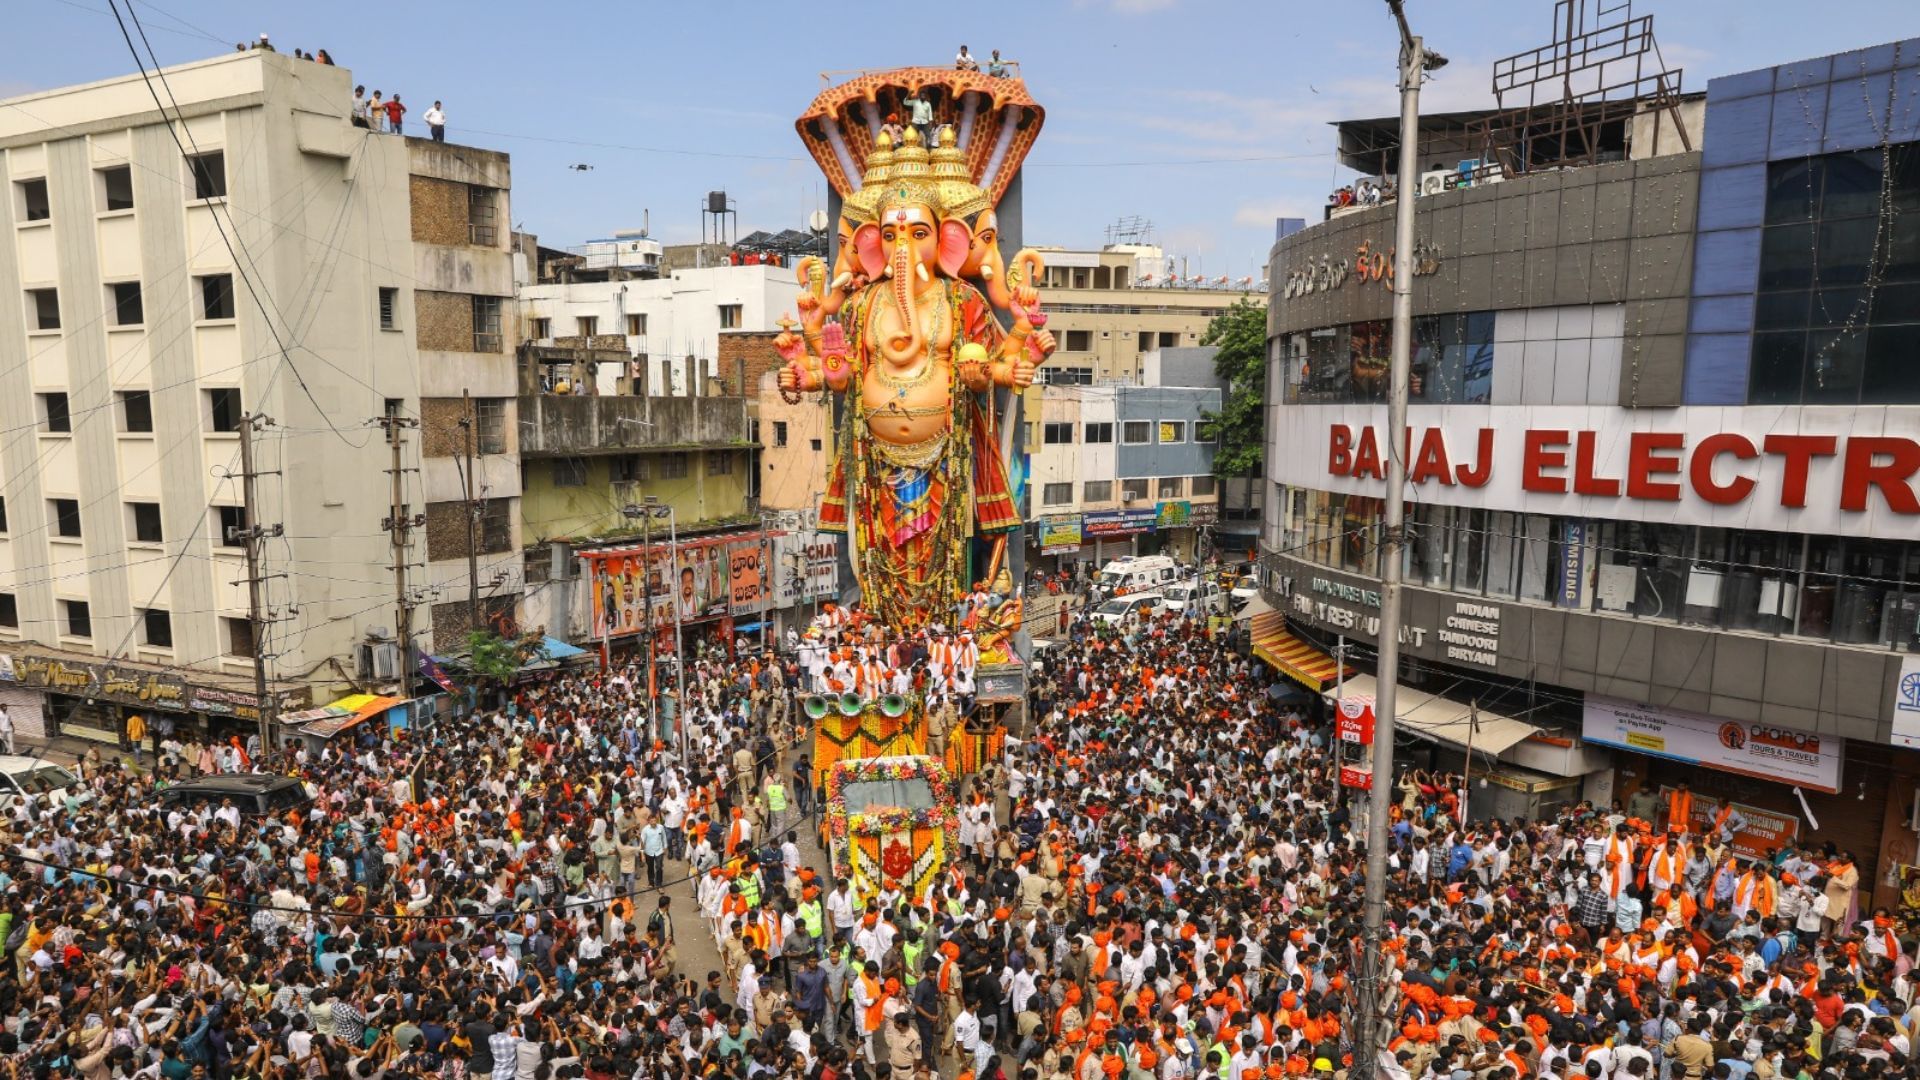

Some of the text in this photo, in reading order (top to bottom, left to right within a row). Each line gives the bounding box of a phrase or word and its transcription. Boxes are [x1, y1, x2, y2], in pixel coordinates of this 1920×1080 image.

[1522, 430, 1920, 514] ELECTR
[1565, 525, 1580, 600] SAMSUNG
[1333, 583, 1359, 603] PURE
[1456, 602, 1499, 619] INDIAN
[1327, 606, 1427, 647] RESTAUNT
[1446, 616, 1498, 635] CHINESE
[1438, 629, 1497, 651] TANDOORI
[1448, 646, 1496, 666] BIRYANI
[1751, 725, 1820, 749] orange
[1750, 743, 1775, 755] TOURS
[1784, 750, 1820, 763] TRAVELS
